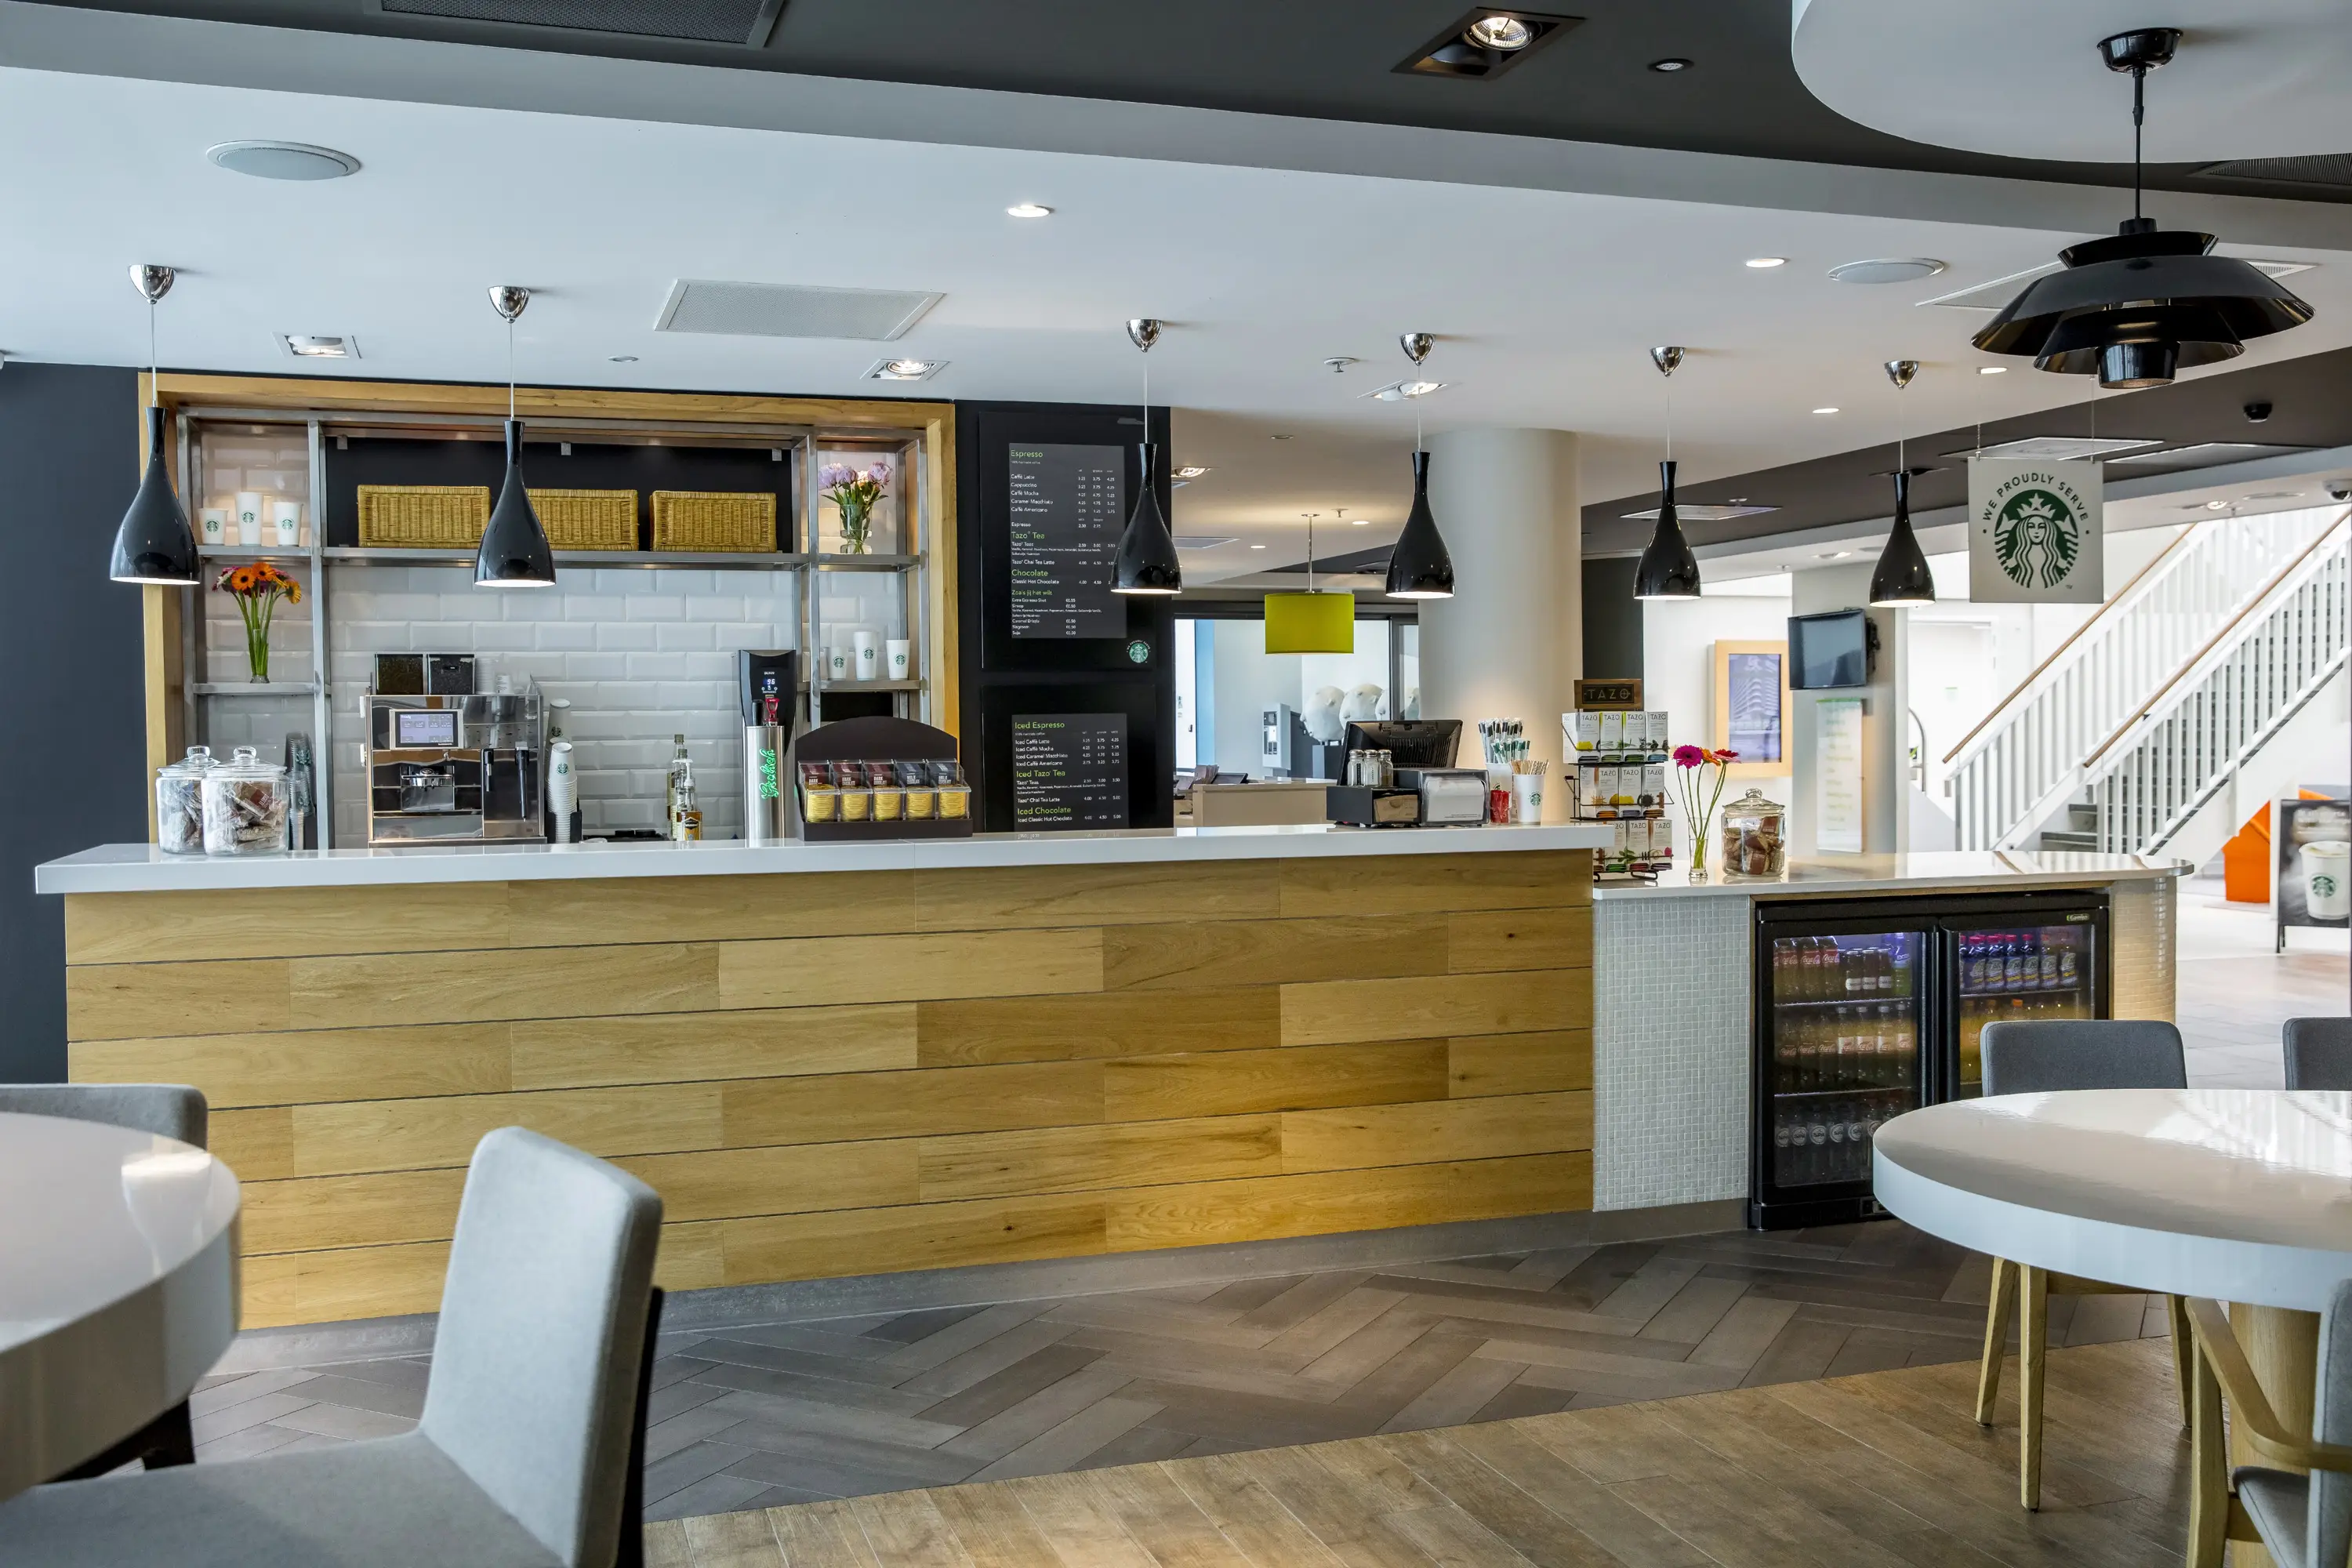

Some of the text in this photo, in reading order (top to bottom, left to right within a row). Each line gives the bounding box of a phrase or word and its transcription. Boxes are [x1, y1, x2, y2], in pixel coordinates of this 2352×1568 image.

[1011, 449, 1044, 459] Espresso
[1982, 472, 2089, 521] WE PROUDLY SERVE
[1588, 688, 1631, 699] TAZO
[1033, 721, 1065, 731] Espresso
[759, 748, 779, 800] Grolsch
